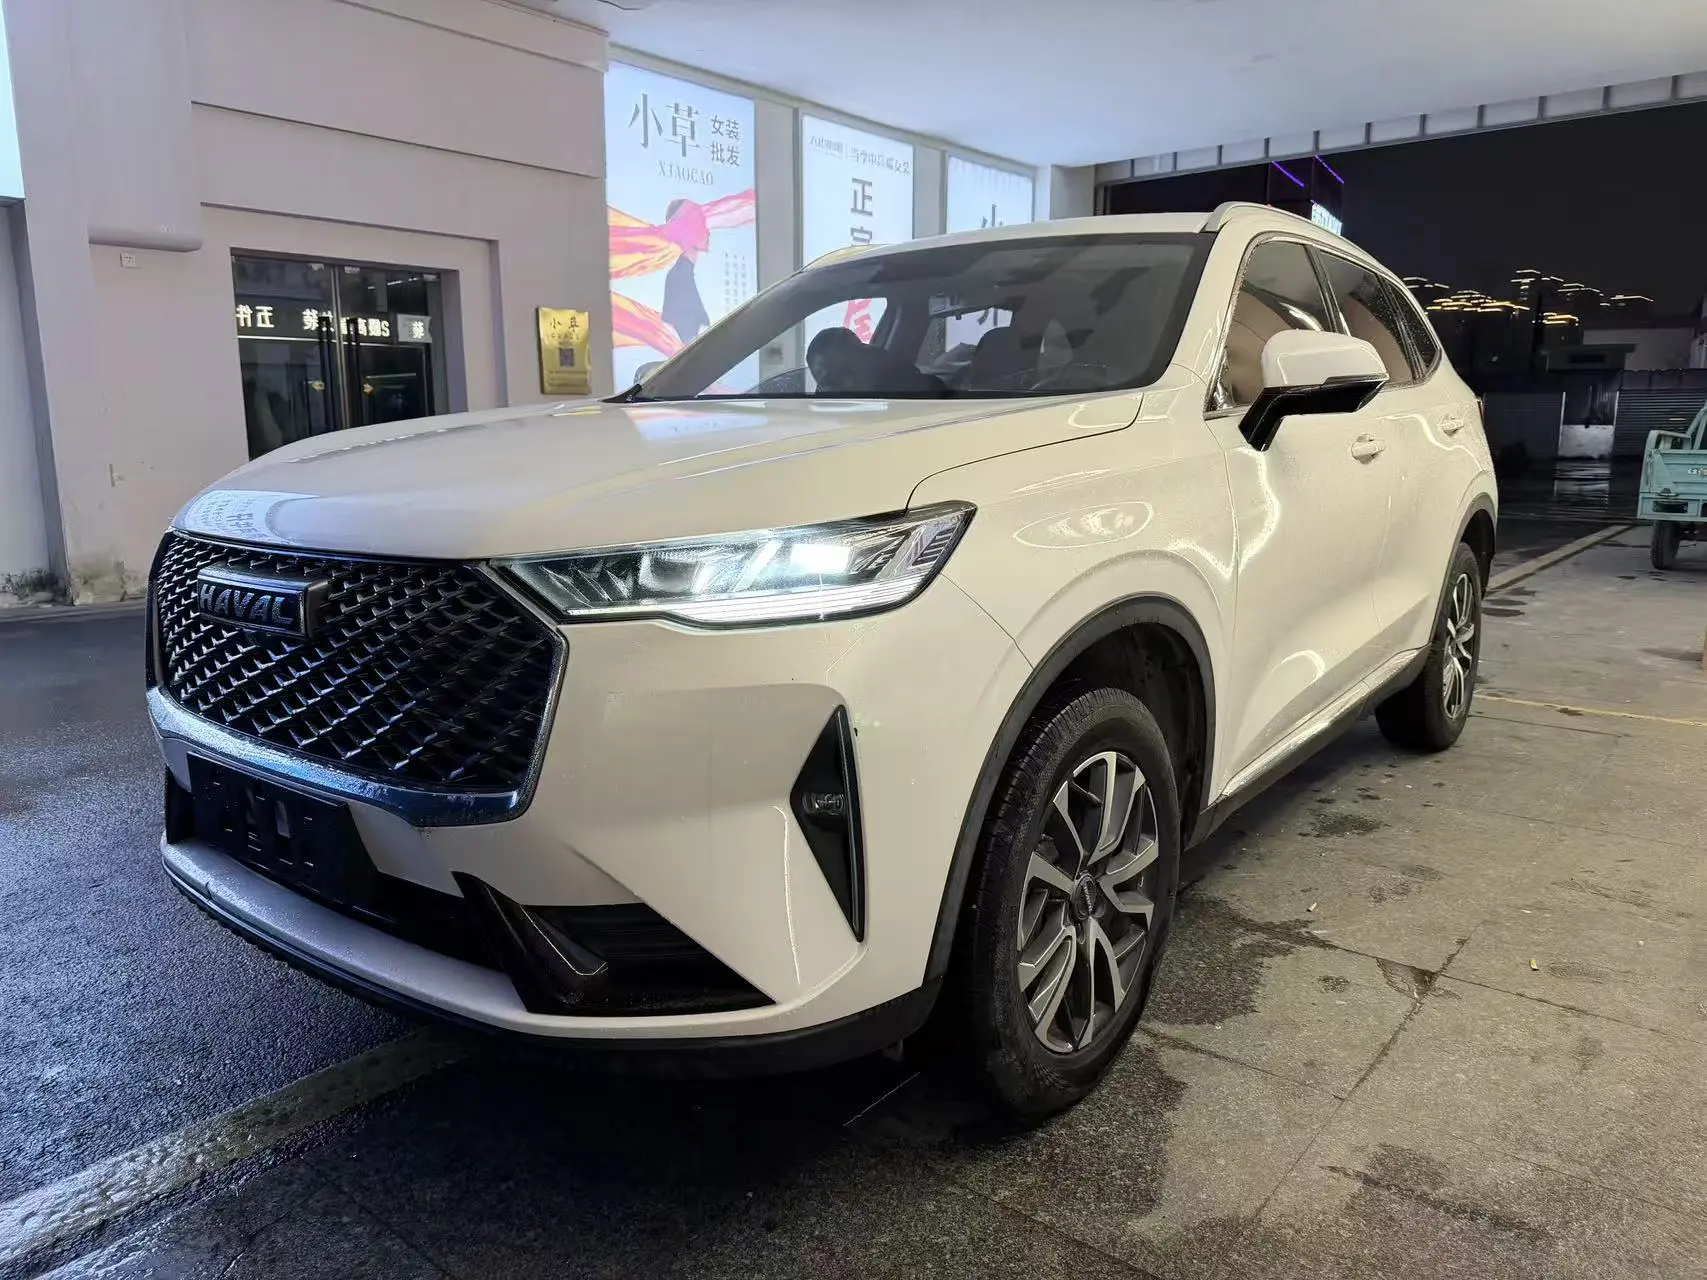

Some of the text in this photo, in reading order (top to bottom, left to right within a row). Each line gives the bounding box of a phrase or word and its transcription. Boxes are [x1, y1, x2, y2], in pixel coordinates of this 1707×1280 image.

[629, 93, 700, 157] 小草
[710, 115, 740, 141] 女装
[710, 142, 740, 167] 批发
[657, 160, 714, 186] XIAOCAO
[200, 584, 293, 624] HAVAL
